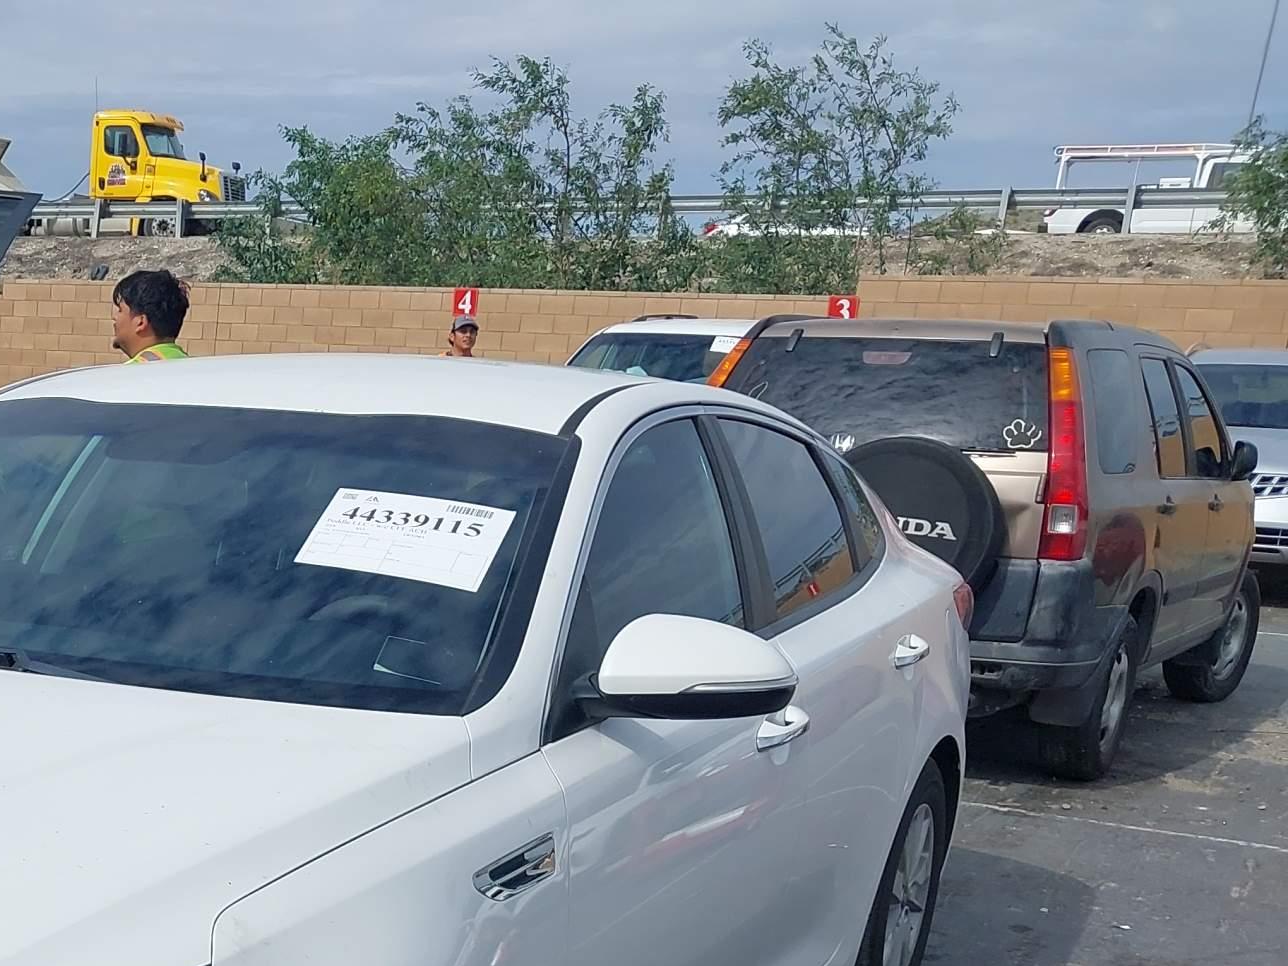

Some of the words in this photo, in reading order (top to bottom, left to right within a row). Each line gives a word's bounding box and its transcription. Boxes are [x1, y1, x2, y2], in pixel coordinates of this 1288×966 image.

[458, 290, 472, 314] 4
[835, 298, 850, 319] 3
[342, 506, 484, 537] 44339115
